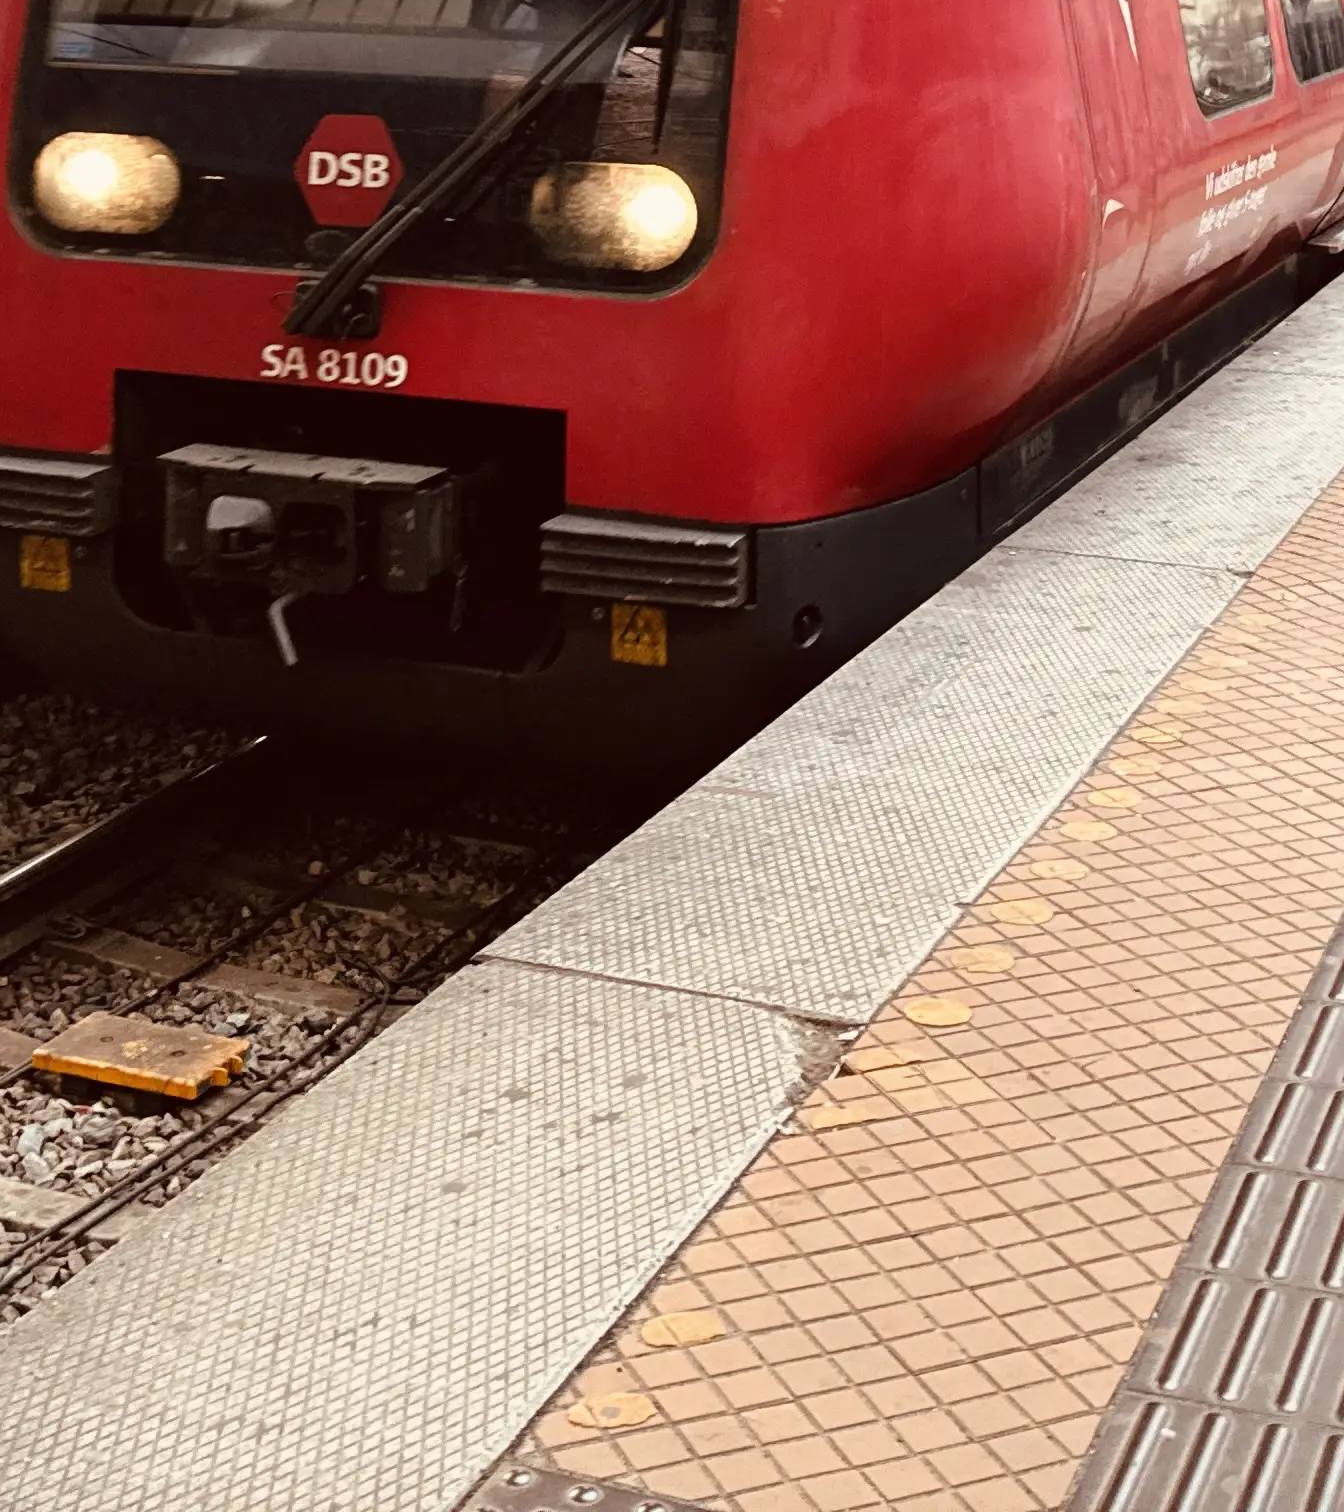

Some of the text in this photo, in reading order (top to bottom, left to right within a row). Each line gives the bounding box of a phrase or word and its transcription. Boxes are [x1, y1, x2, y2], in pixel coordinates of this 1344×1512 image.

[307, 150, 390, 188] DSB
[259, 343, 409, 388] SA 8109
